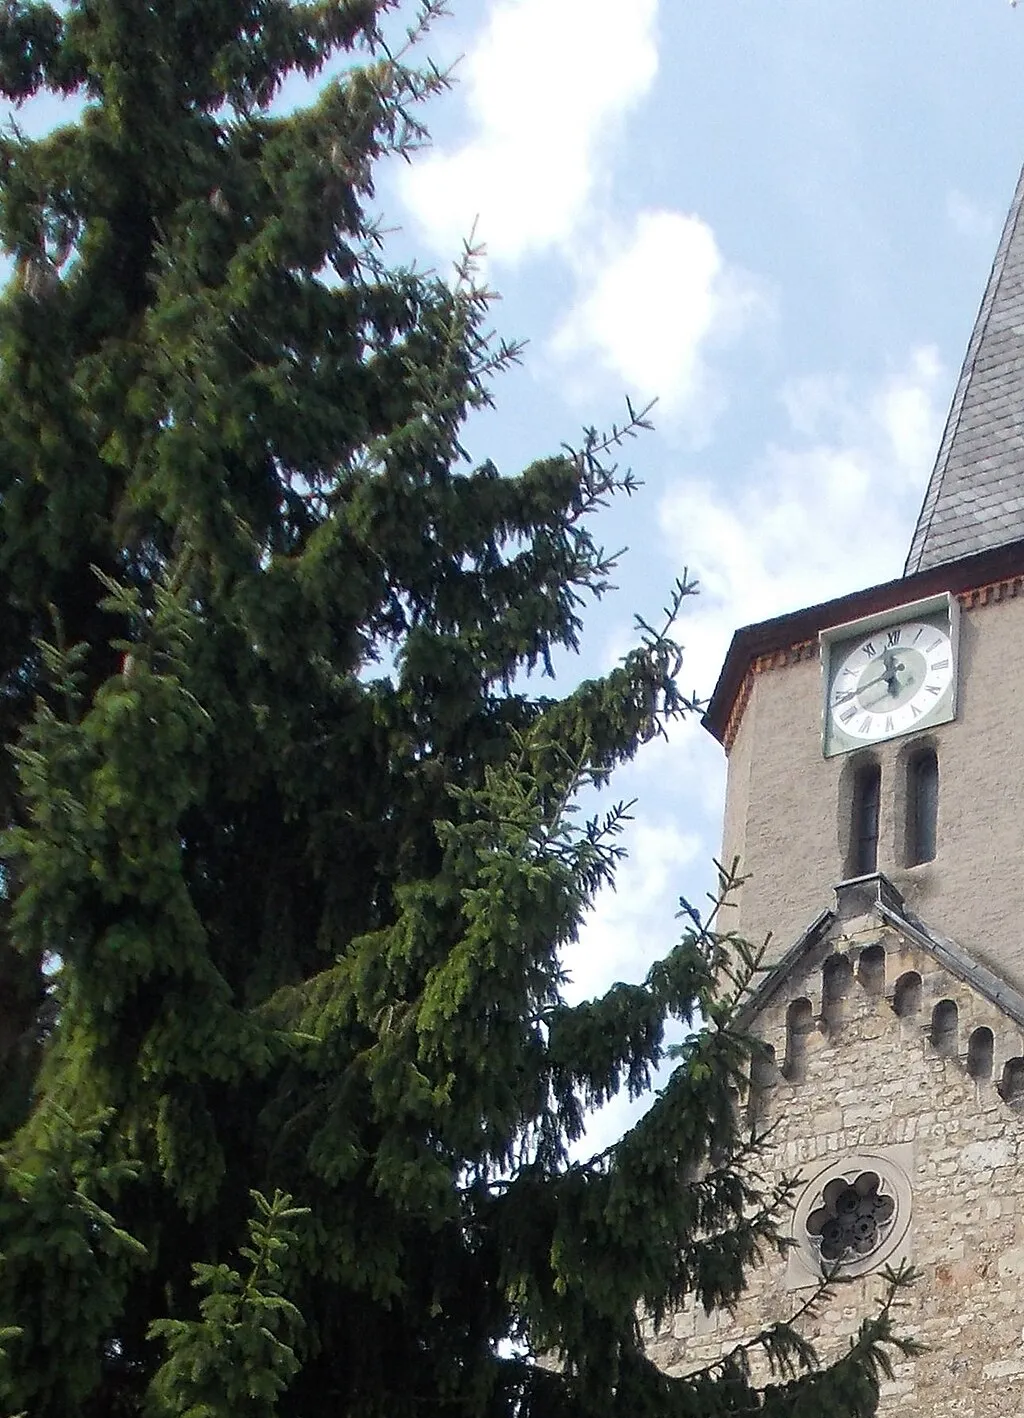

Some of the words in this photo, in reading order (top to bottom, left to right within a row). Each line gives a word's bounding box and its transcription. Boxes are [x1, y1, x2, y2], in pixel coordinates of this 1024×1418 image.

[887, 629, 901, 647] XII
[912, 629, 922, 645] I
[863, 642, 877, 658] XI
[926, 638, 942, 653] II
[843, 668, 859, 677] X
[931, 659, 948, 671] III
